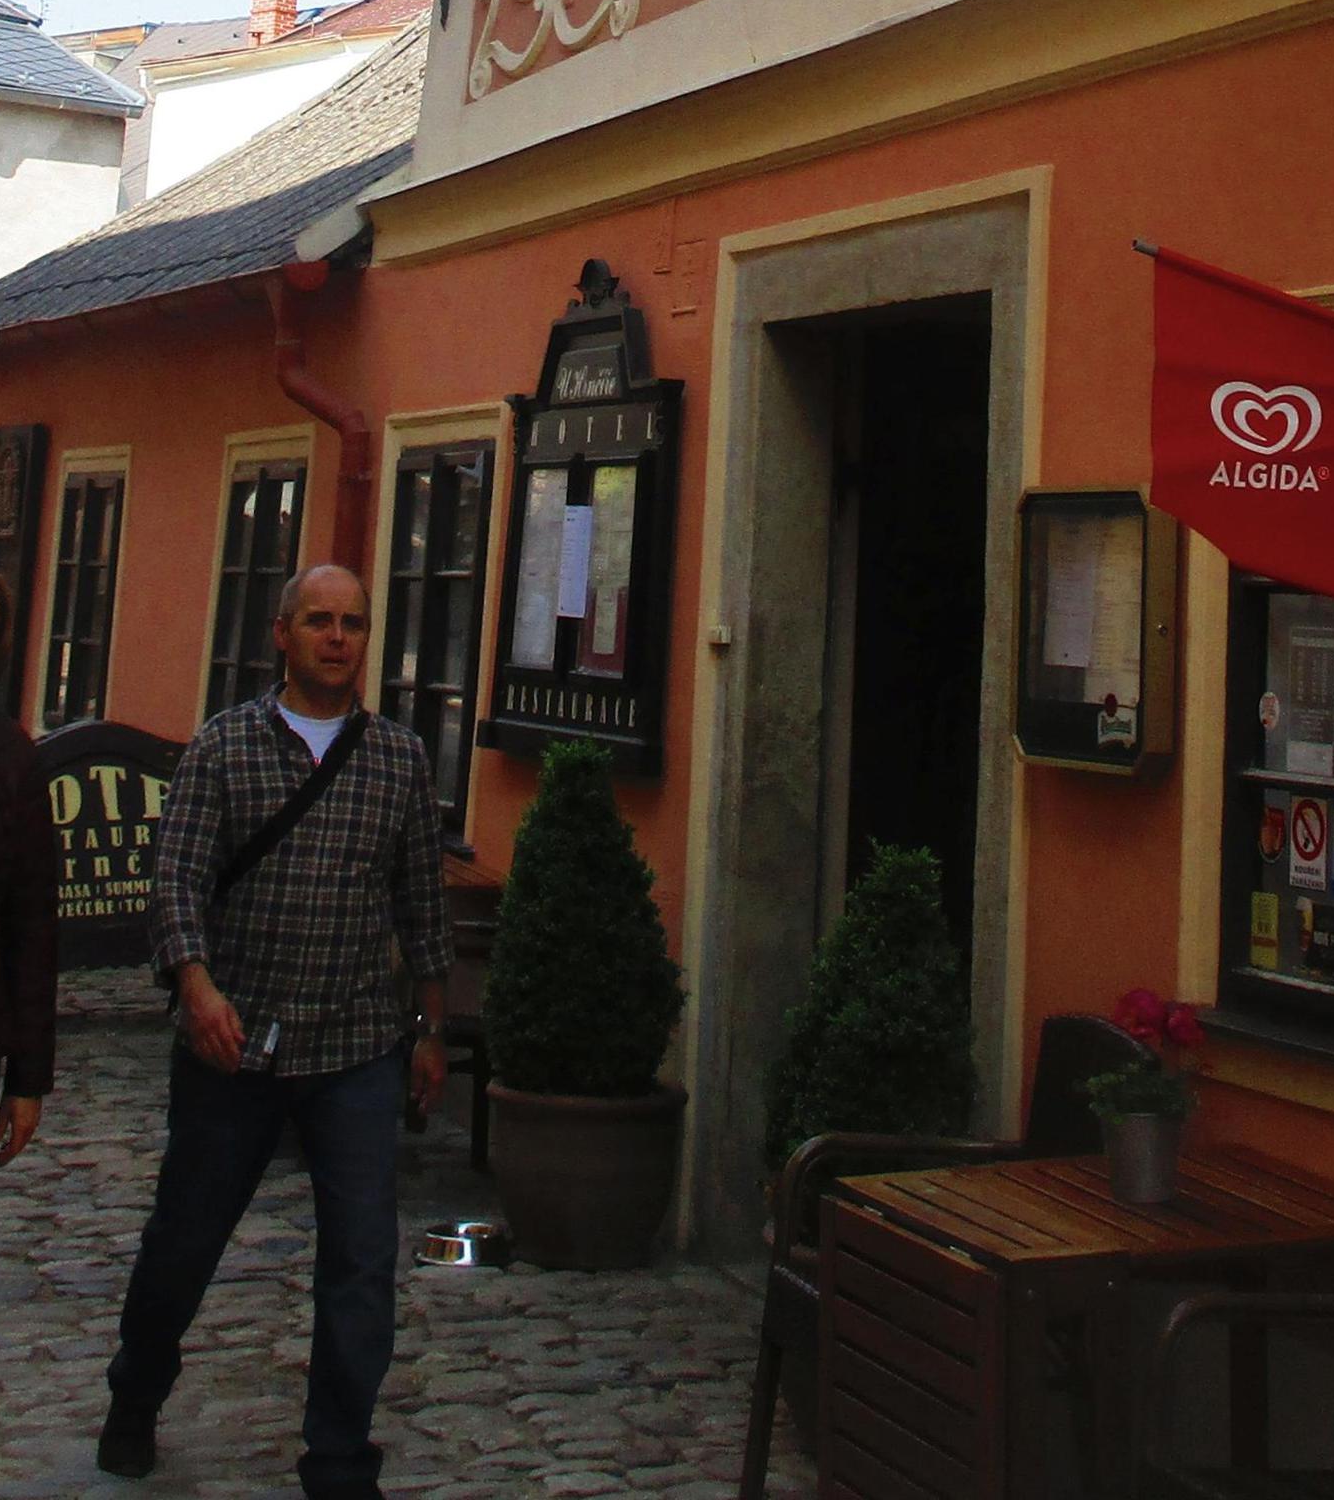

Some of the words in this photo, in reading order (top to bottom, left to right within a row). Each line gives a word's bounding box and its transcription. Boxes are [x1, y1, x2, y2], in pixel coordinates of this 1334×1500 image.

[530, 411, 653, 447] HOTEL
[1208, 461, 1321, 493] ALGIDA
[505, 683, 636, 728] RESTAURACE
